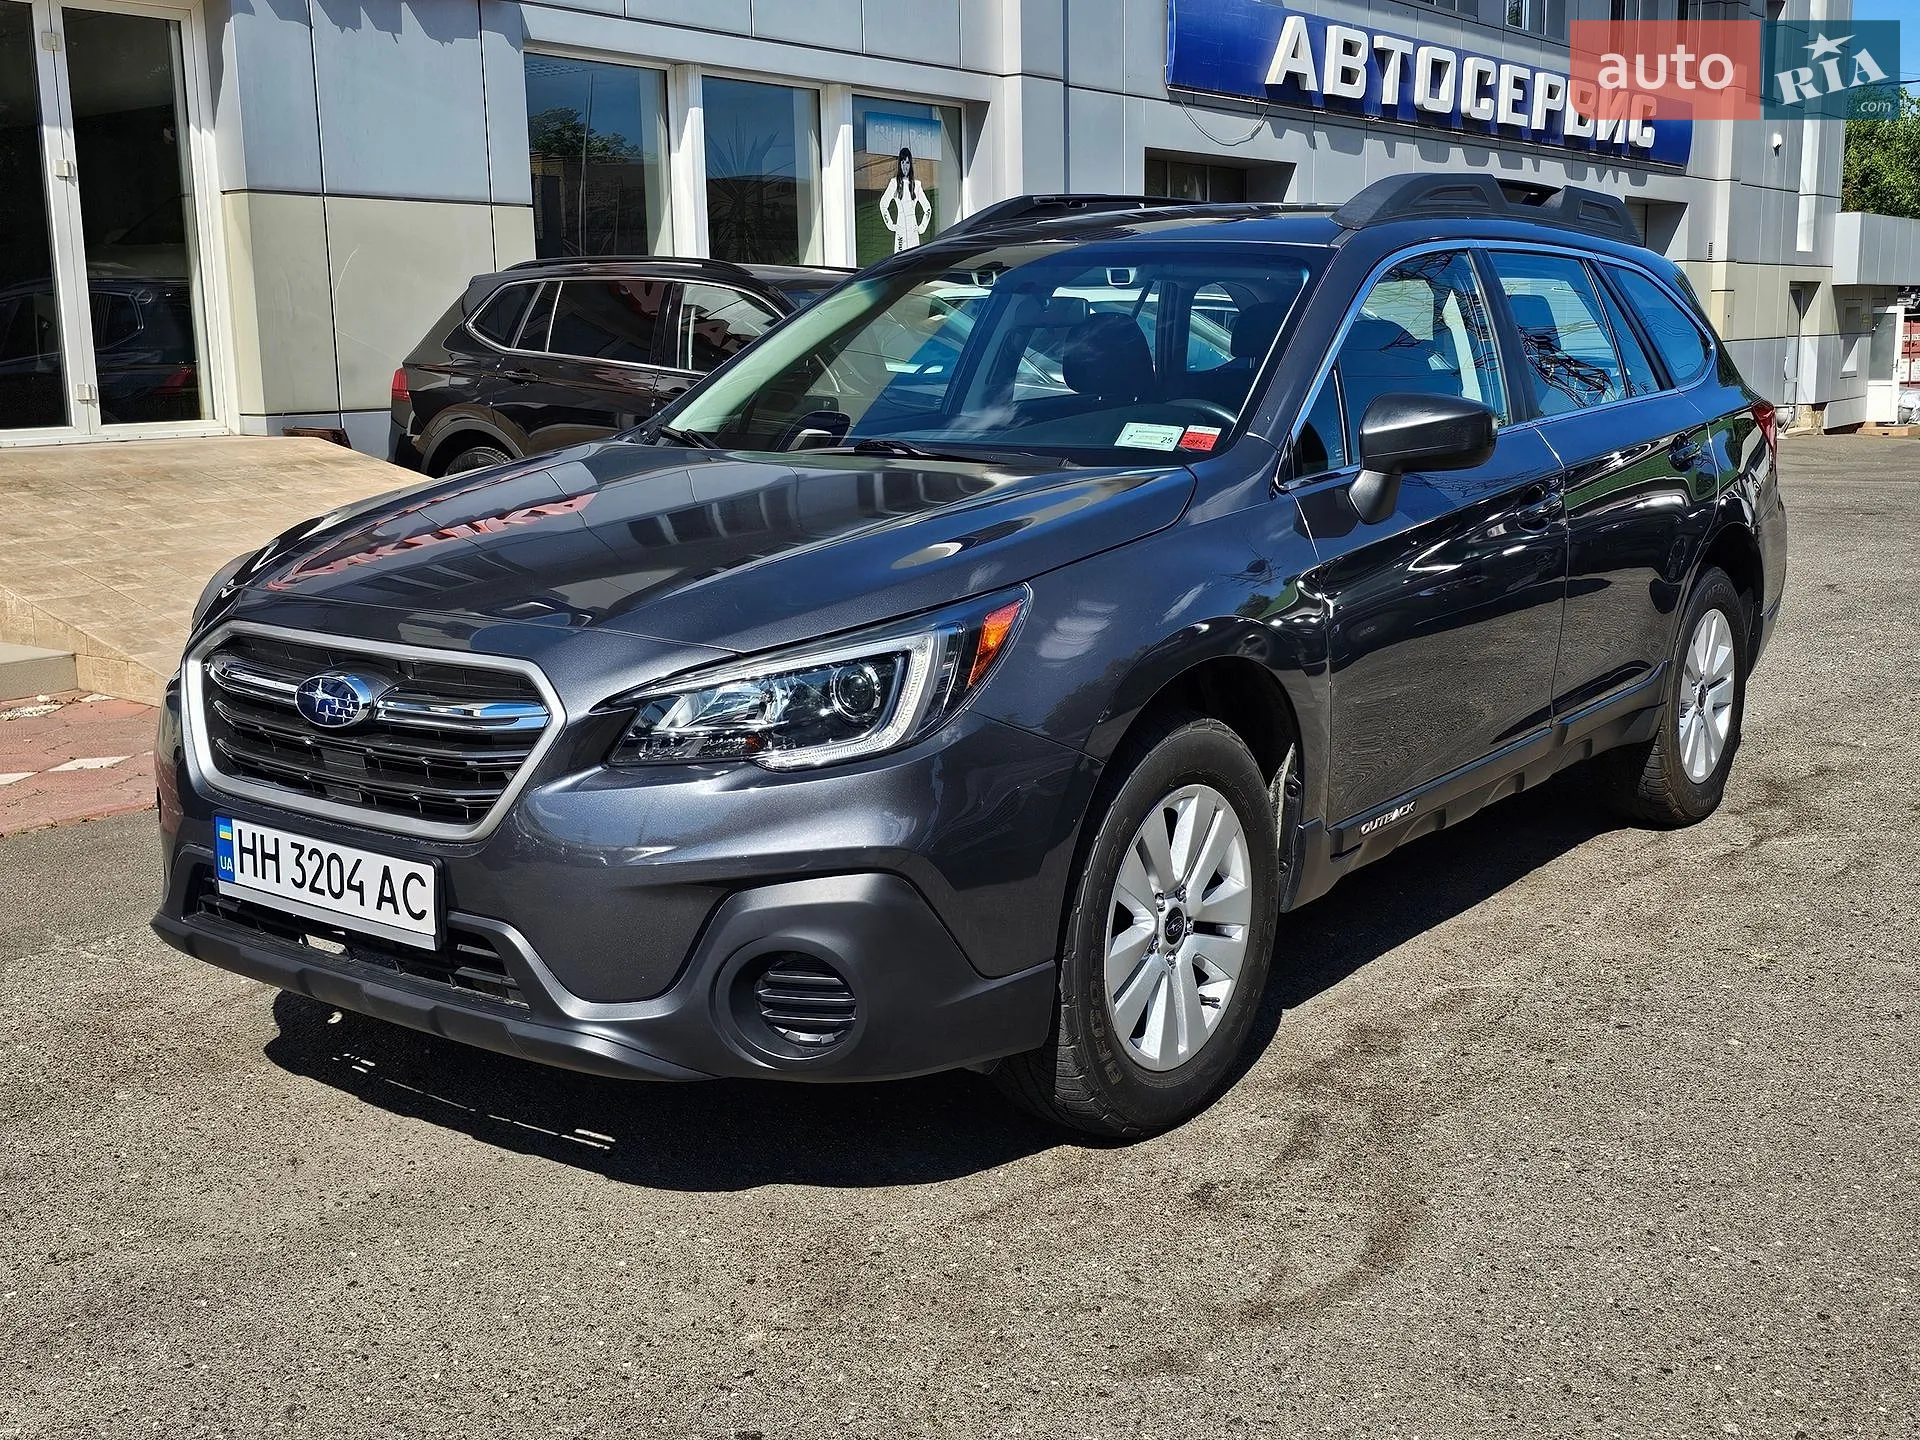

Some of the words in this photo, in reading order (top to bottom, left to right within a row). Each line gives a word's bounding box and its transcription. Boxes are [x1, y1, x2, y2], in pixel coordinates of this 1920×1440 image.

[1265, 15, 1657, 149] АВТОСЕРВИС
[1160, 436, 1173, 444] 25
[1361, 801, 1416, 834] OUTBACK
[220, 856, 233, 872] UA
[238, 828, 281, 883] HH
[290, 841, 365, 907] 3204
[376, 864, 427, 921] AC
